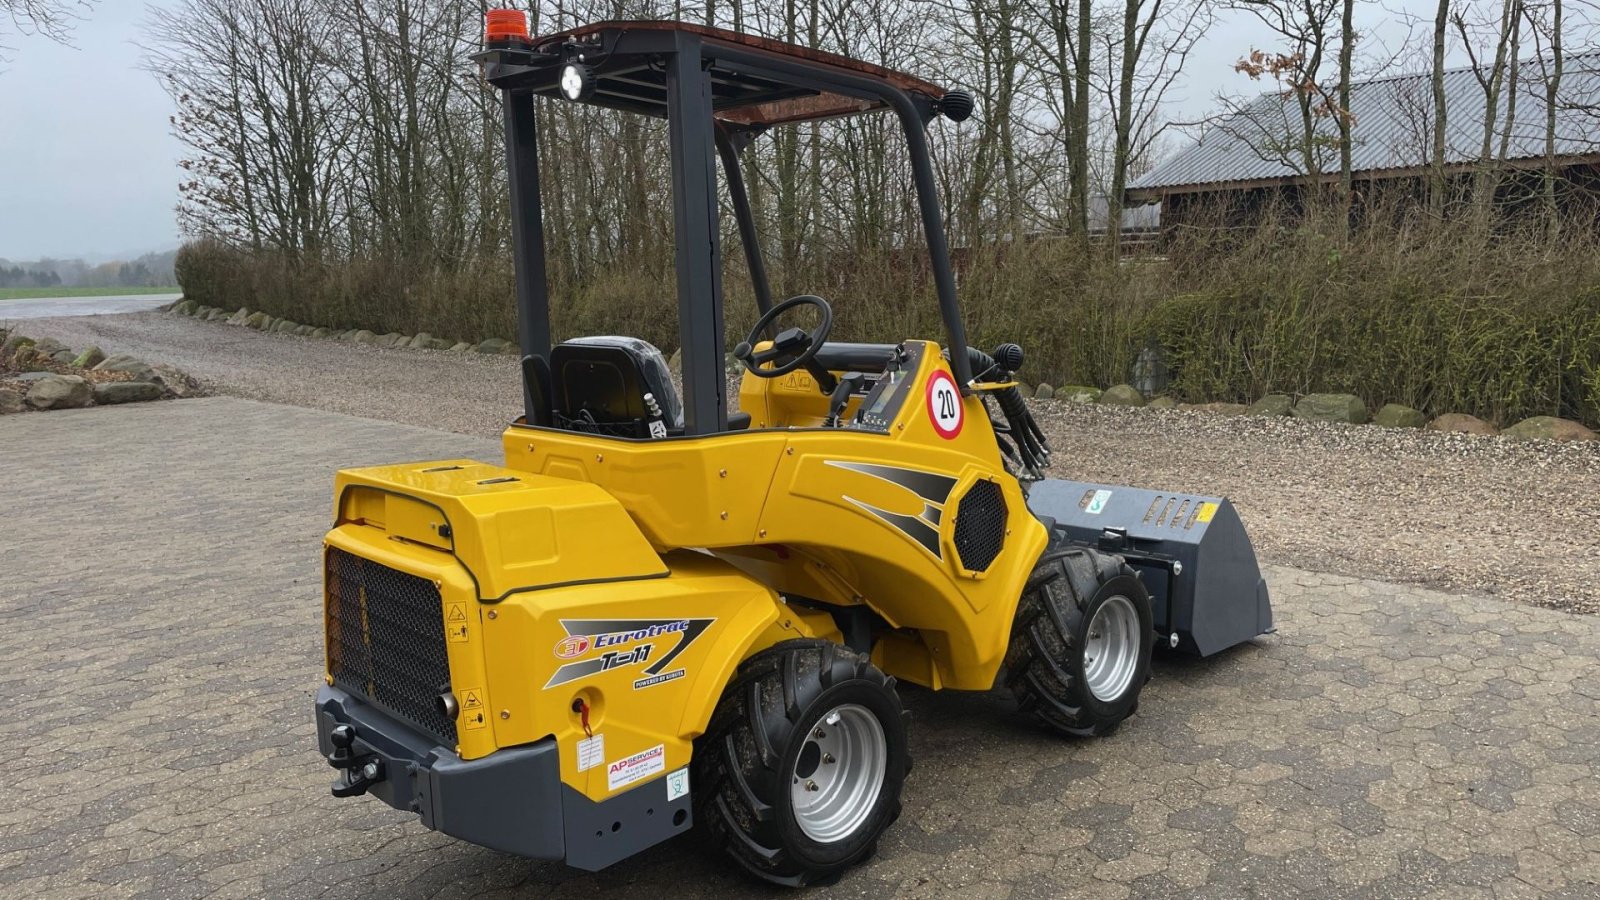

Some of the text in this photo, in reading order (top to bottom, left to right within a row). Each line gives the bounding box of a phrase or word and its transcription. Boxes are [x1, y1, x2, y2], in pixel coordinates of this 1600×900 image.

[938, 389, 955, 419] 20
[594, 620, 689, 649] Eurotrac
[635, 677, 659, 688] POWERED
